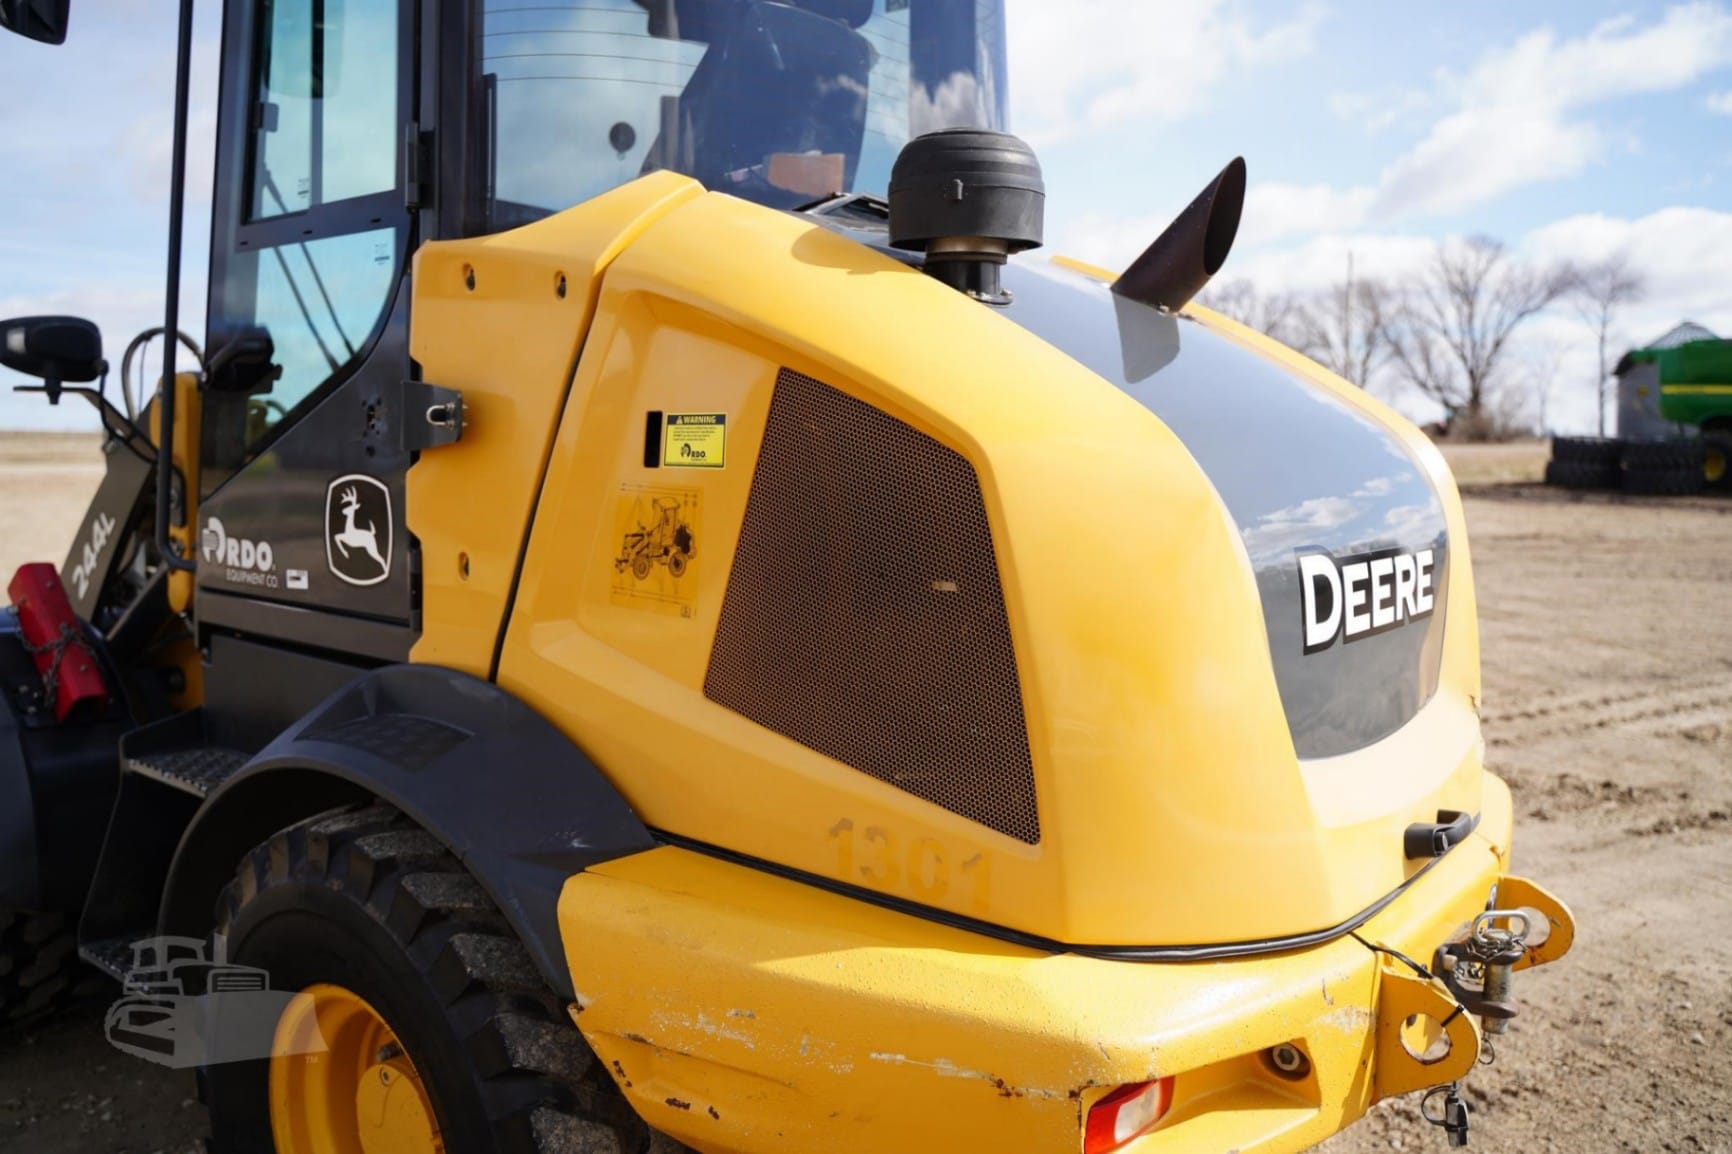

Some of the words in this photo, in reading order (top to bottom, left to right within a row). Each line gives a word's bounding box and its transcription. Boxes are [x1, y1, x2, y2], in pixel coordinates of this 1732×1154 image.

[683, 415, 716, 424] WARNING
[72, 511, 116, 600] 244L
[1298, 549, 1434, 648] DEERE
[828, 817, 992, 915] 1301
